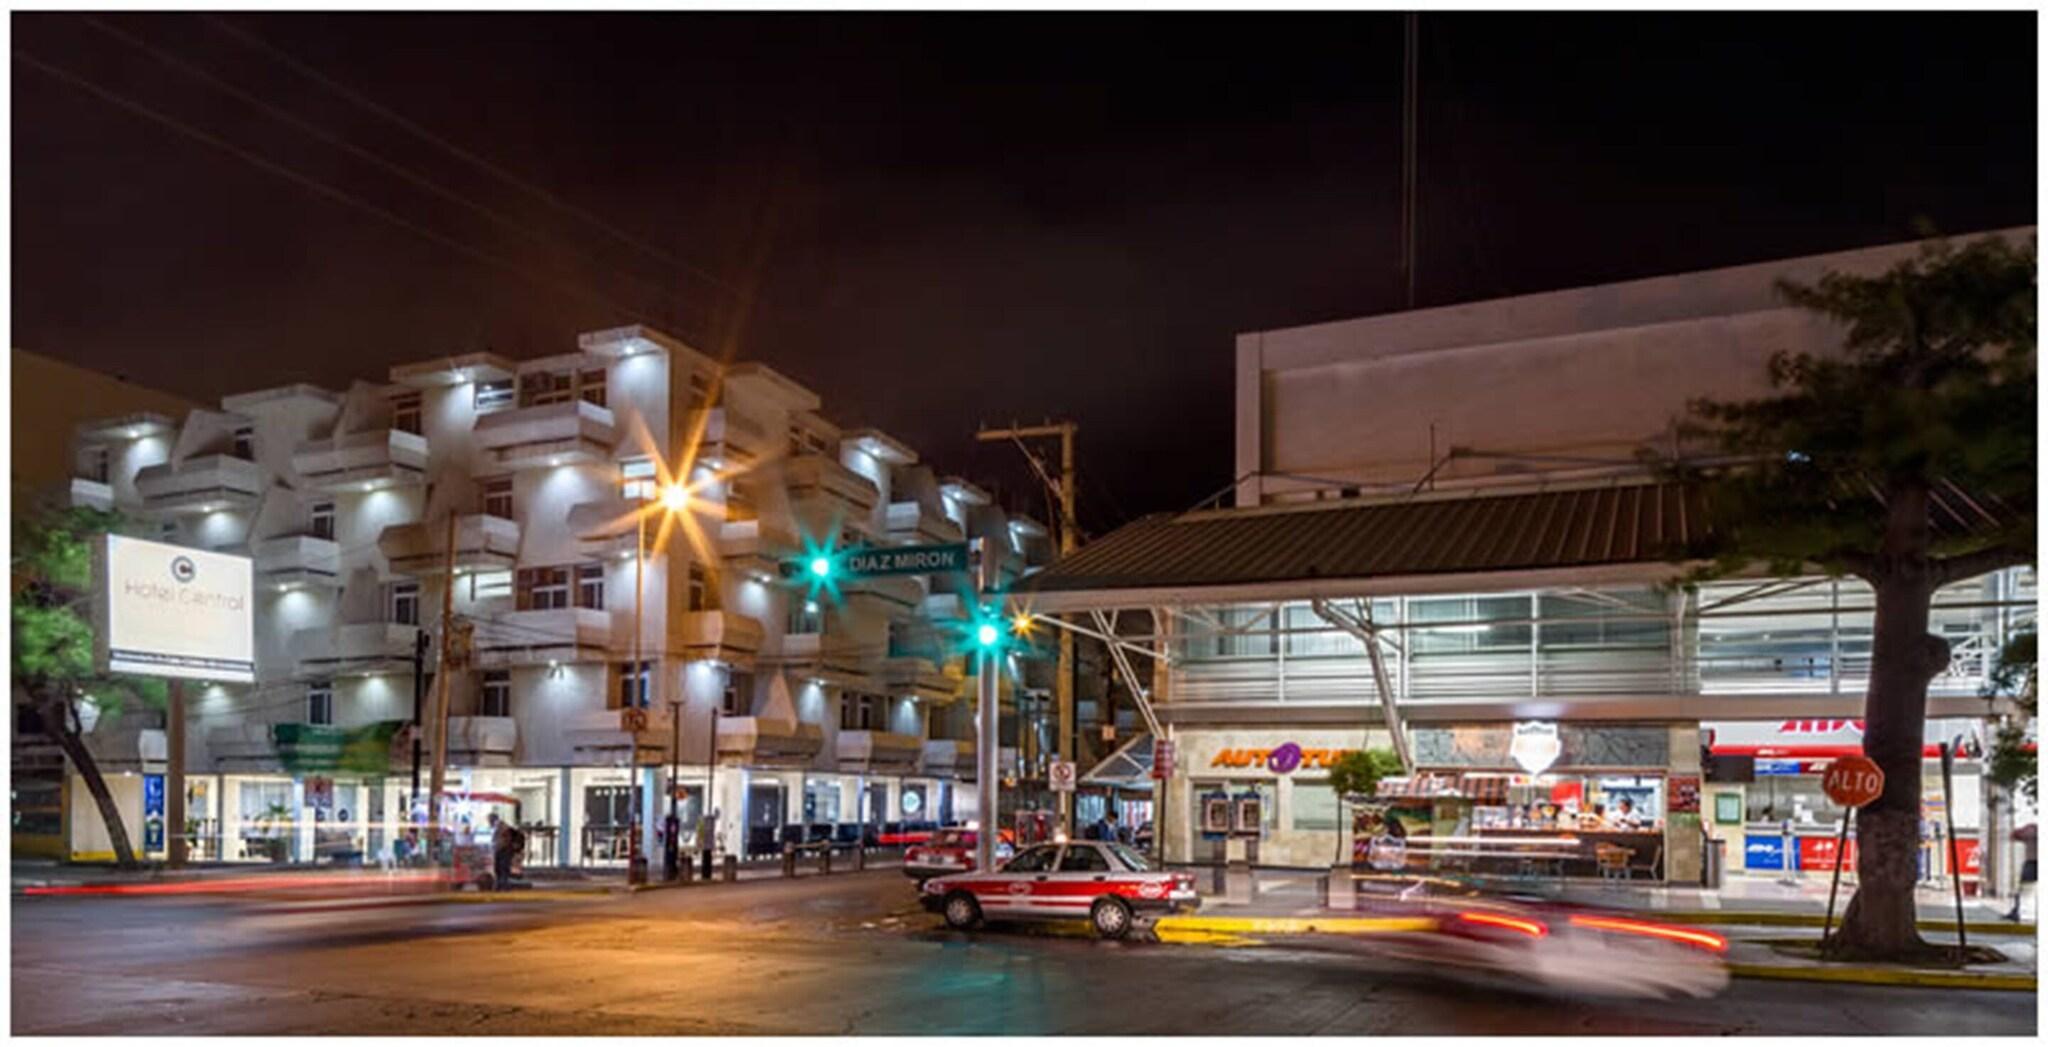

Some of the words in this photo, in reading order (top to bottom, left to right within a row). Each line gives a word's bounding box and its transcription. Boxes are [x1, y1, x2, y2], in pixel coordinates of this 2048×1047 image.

[849, 555, 892, 572] DIAZ
[894, 552, 955, 569] MIRON
[124, 577, 175, 602] Hotel
[178, 587, 244, 611] Central
[1827, 770, 1878, 793] ALTO
